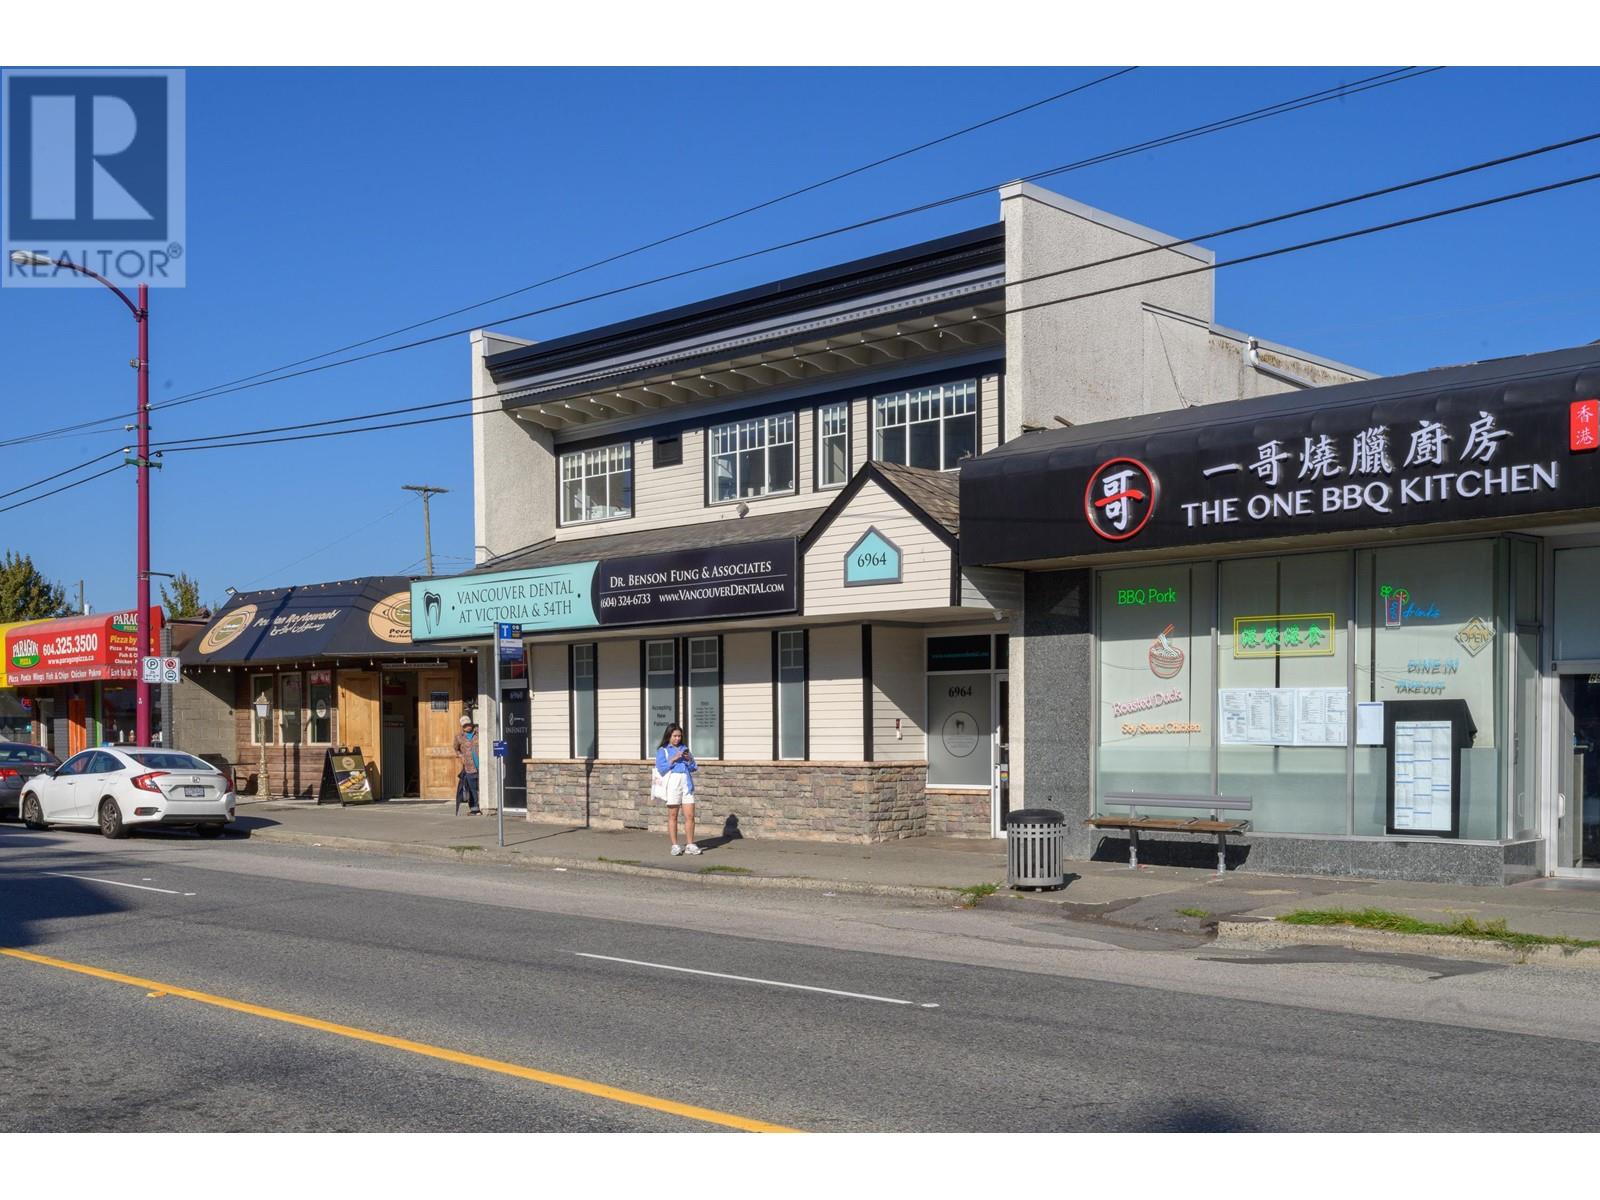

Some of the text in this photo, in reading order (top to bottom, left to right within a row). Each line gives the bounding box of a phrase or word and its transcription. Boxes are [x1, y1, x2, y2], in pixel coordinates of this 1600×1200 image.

[1576, 404, 1594, 445] 香港
[1202, 410, 1513, 487] 一哥燒臘廚房
[1181, 460, 1558, 527] THE ONE BBQ KITCHEN
[857, 552, 887, 568] 6964
[702, 567, 710, 578] &
[457, 580, 574, 604] VANCOUVER DENTAL
[1118, 587, 1177, 605] BBQ Pork
[600, 593, 651, 608] (604) 324-6733
[113, 613, 138, 625] PARA
[459, 600, 572, 623] AT VICTORIA & 54TH
[42, 633, 98, 656] 604.325.3500
[110, 635, 128, 644] Pizza
[1460, 632, 1489, 643] OPEN
[12, 638, 39, 657] PARAGON
[1407, 659, 1459, 675] DINE IN
[948, 685, 972, 698] 6964
[1394, 680, 1446, 695] TAKE OUT
[1112, 689, 1183, 717] Roasted Duck
[1121, 722, 1138, 737] Soy
